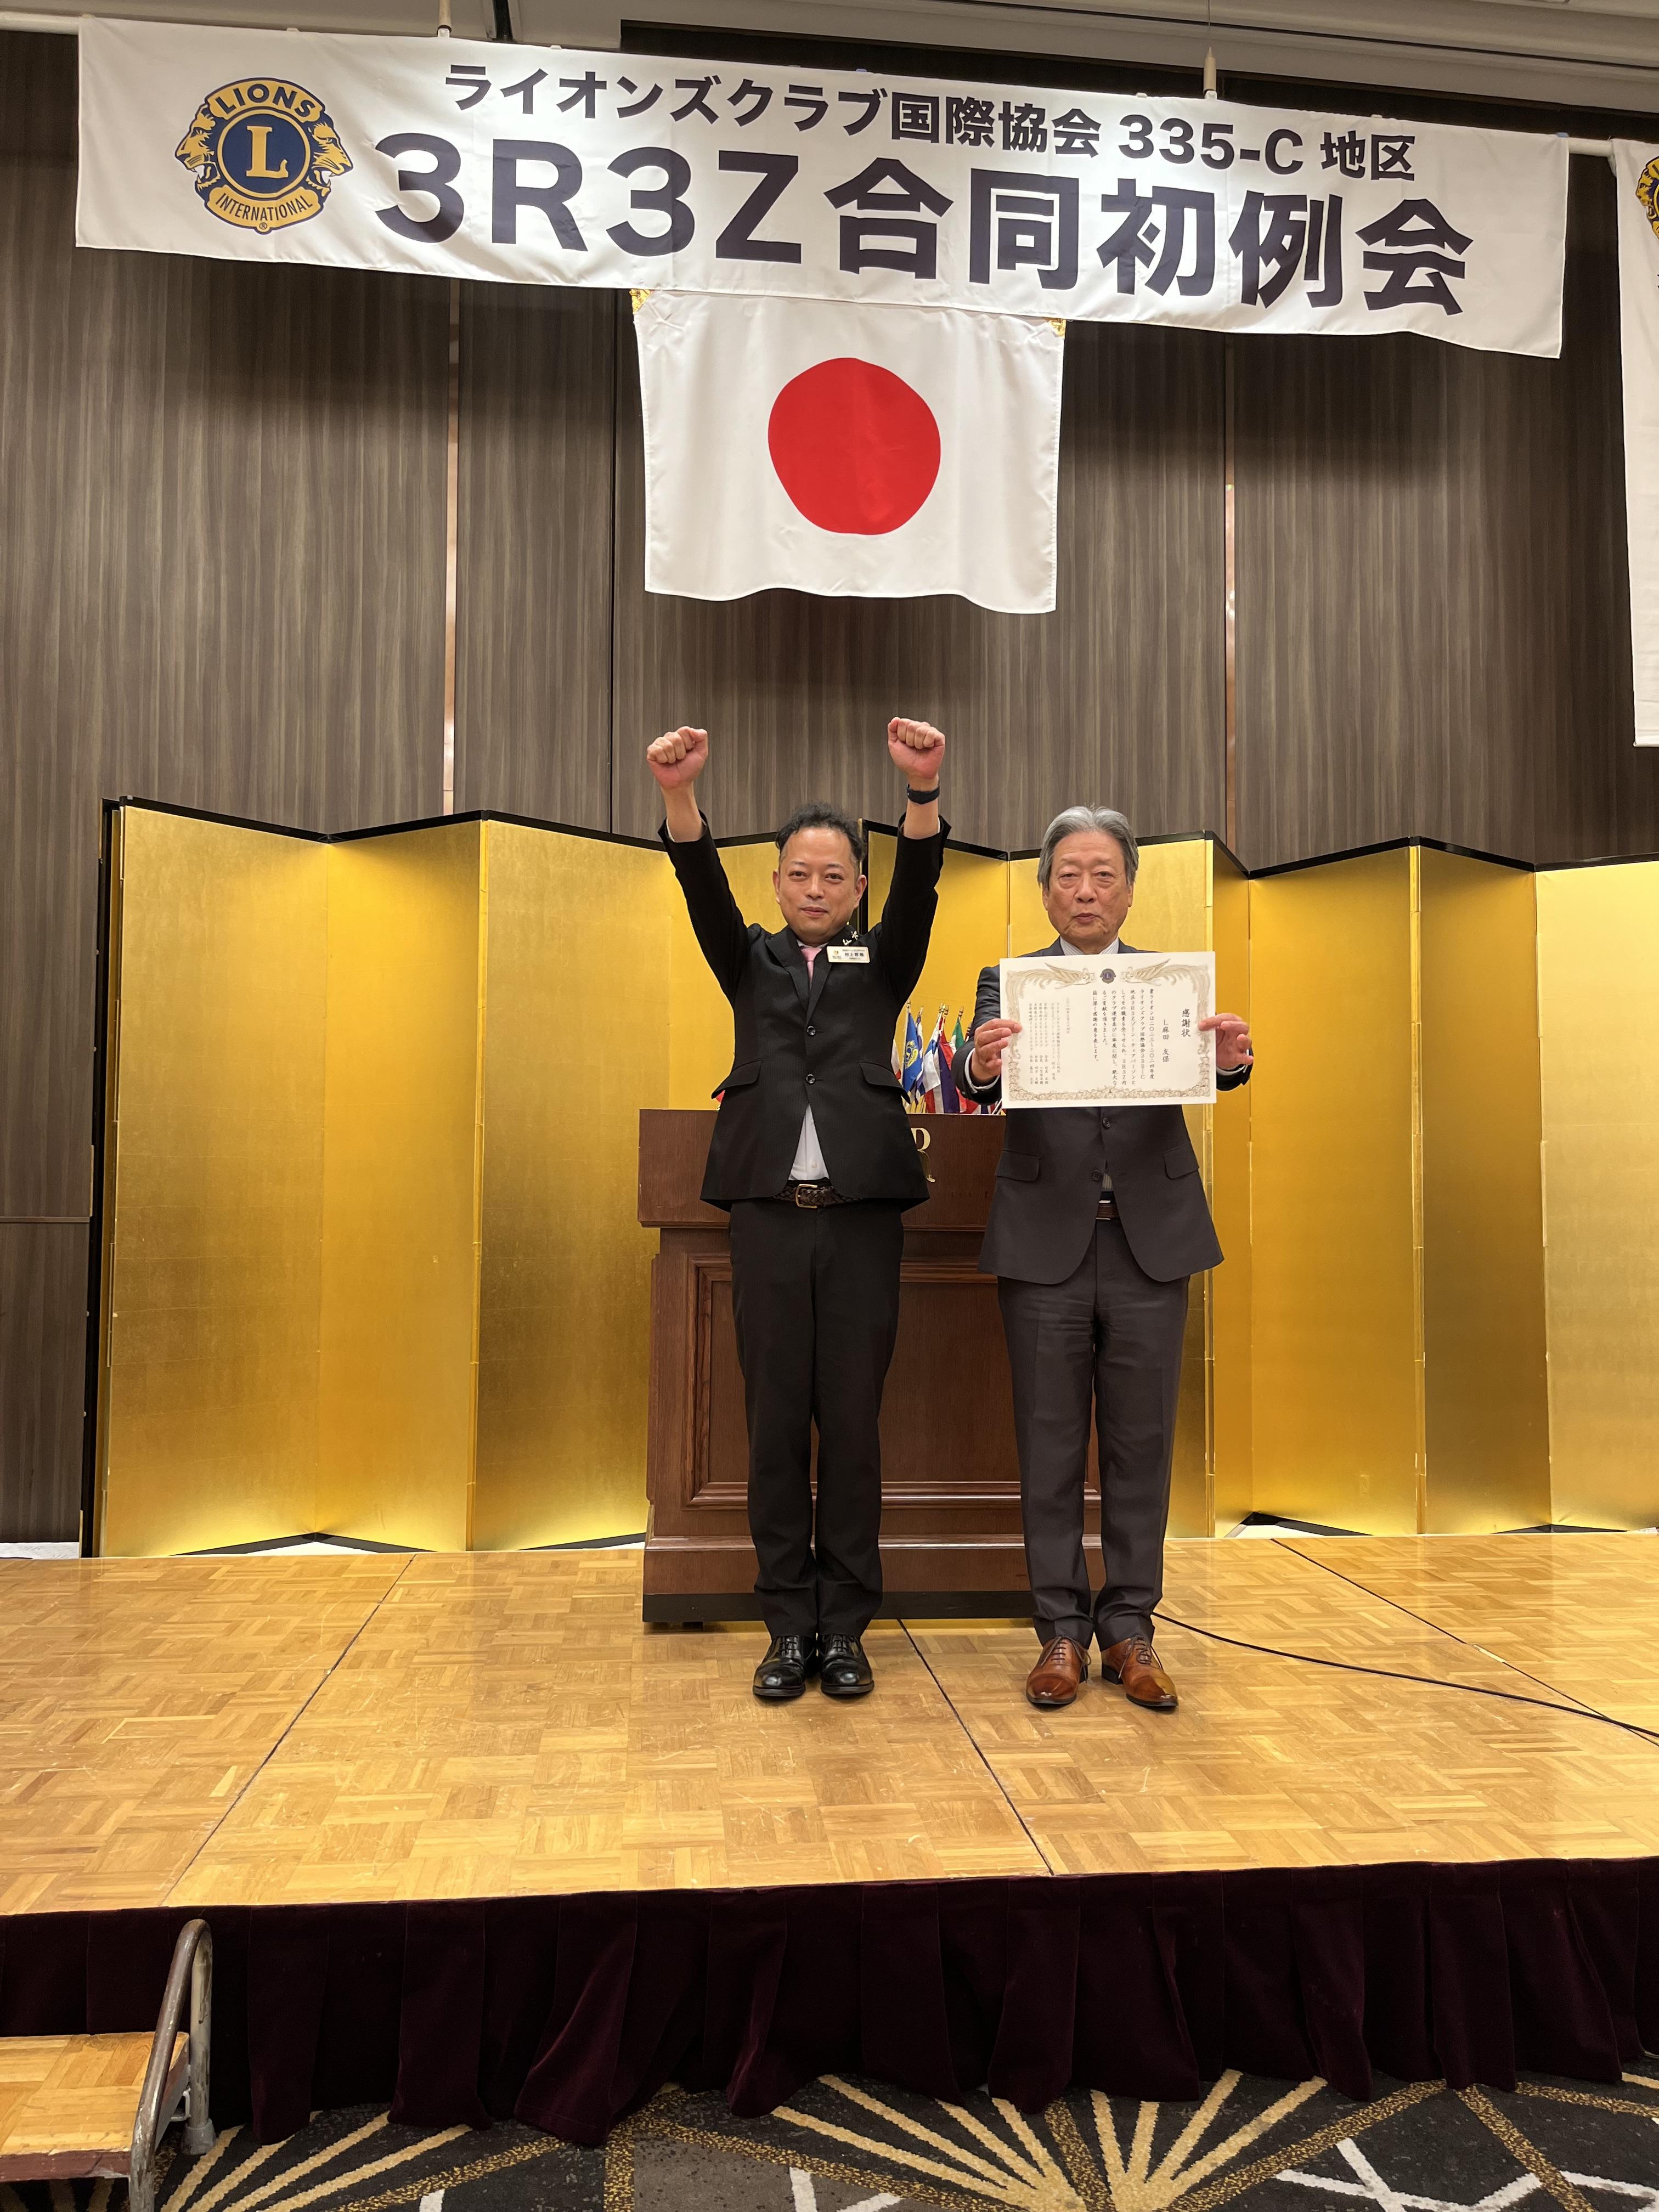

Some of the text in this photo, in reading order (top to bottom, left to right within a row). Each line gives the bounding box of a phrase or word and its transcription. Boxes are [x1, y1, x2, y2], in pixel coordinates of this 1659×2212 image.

[215, 84, 315, 117] LIONS
[446, 65, 1415, 181] ライオンズクラブ国際協会 335-C 地区
[246, 125, 289, 179] L
[215, 193, 313, 222] INTERNATIONAL
[375, 132, 1473, 315] 3R3Z合同初例会
[1181, 1008, 1191, 1037] 感謝状
